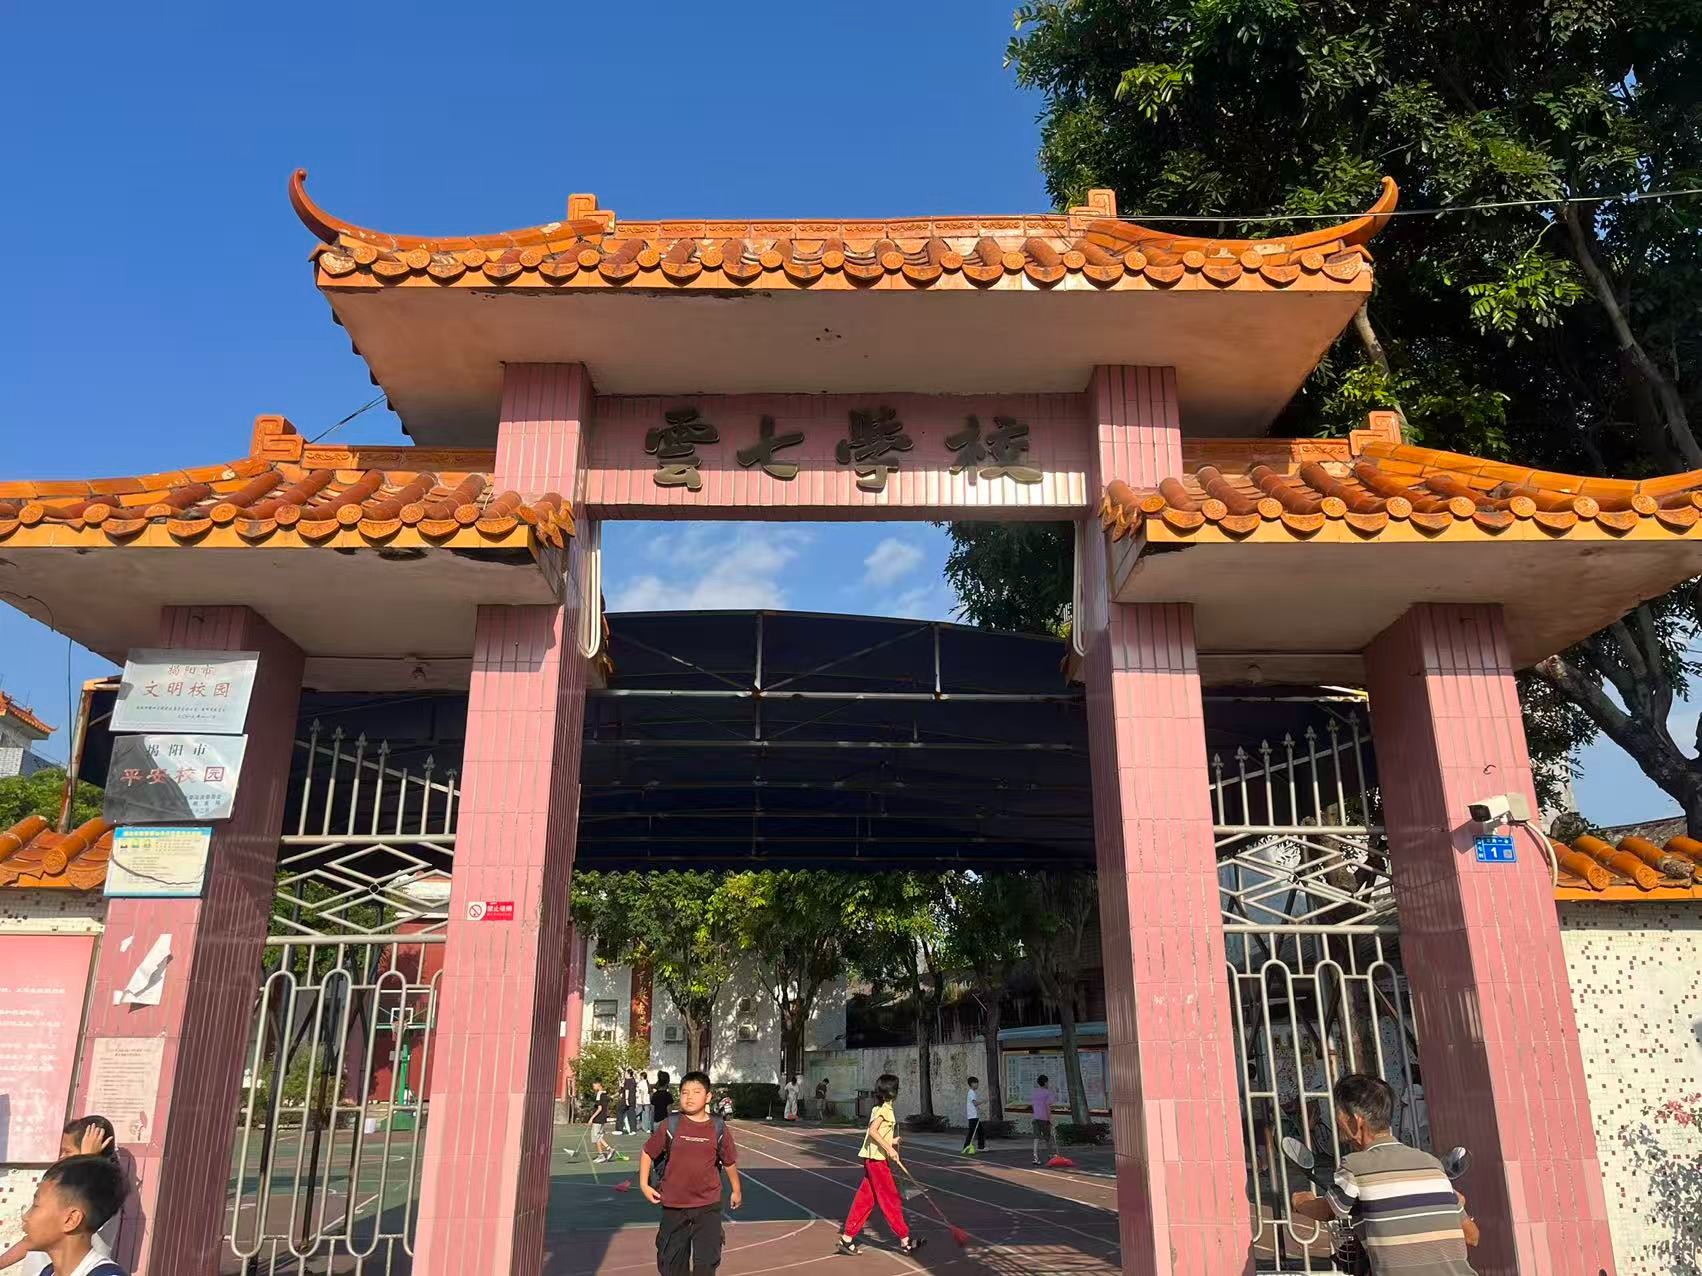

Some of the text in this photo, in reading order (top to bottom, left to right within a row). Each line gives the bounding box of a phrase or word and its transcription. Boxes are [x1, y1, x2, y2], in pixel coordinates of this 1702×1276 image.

[643, 407, 1043, 491] 雲七學校
[168, 664, 215, 677] 揭阳市
[143, 680, 233, 698] 文明校园
[148, 743, 208, 757] 揭阳市
[120, 767, 225, 786] 平安校园
[1491, 846, 1498, 858] 1
